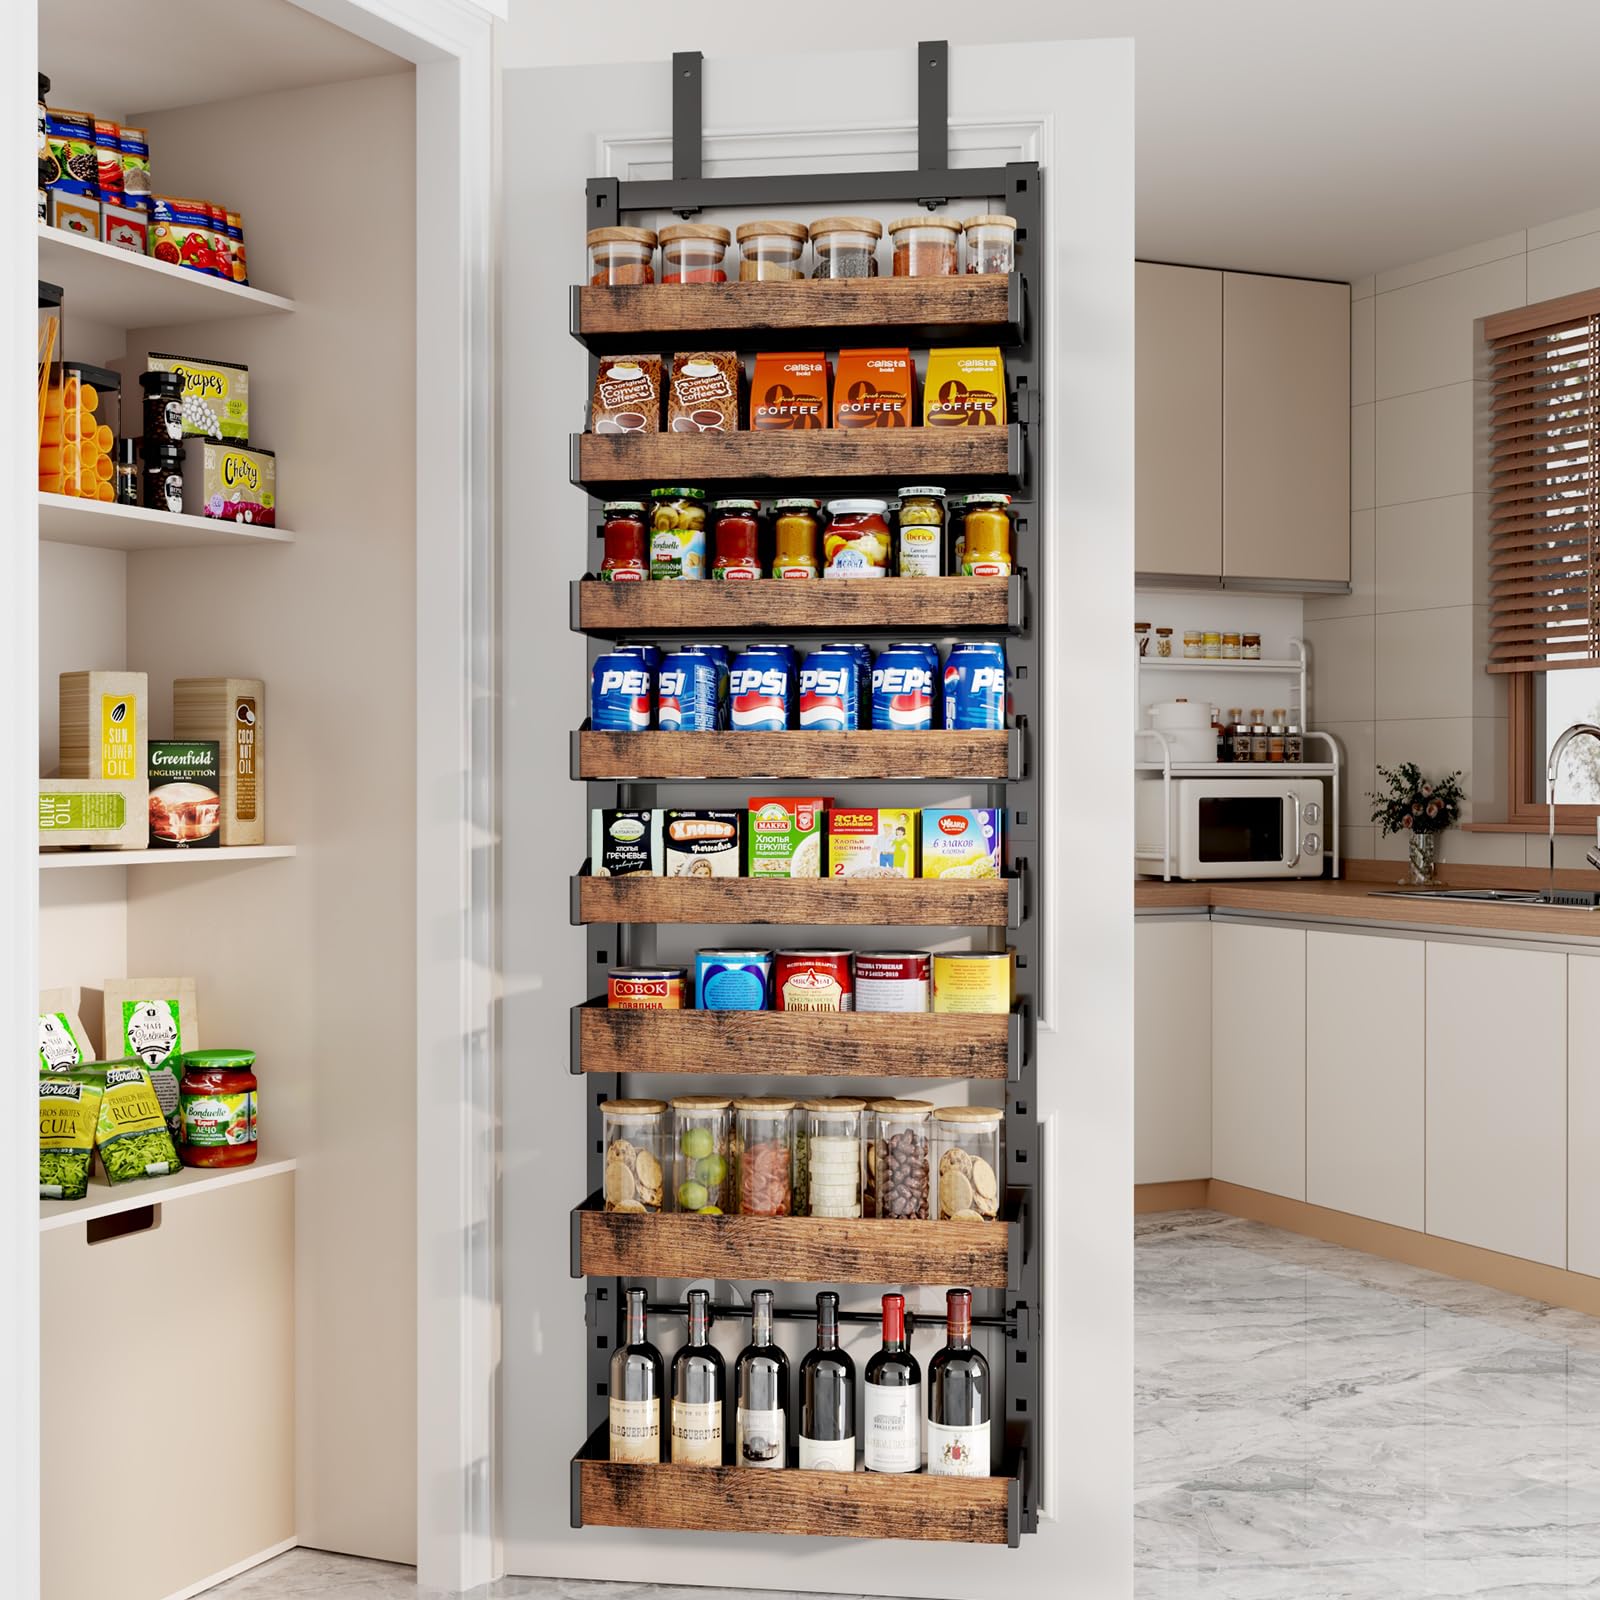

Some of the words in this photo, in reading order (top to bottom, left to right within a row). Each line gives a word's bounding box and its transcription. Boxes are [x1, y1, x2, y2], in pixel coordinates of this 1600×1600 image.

[617, 377, 647, 389] original
[692, 375, 722, 386] original
[604, 384, 649, 398] Conven
[680, 381, 725, 395] Conven
[606, 393, 636, 404] coffee
[682, 390, 714, 401] coffee
[757, 405, 819, 416] COFFEE
[840, 402, 902, 412] COFFEE
[931, 401, 993, 412] COFFEE
[225, 457, 257, 489] Cherry
[906, 533, 932, 541] Iberica
[109, 727, 128, 743] SUN
[238, 729, 254, 744] COCO
[104, 743, 133, 759] FLOWER
[239, 744, 252, 758] NUT
[152, 750, 212, 766] Greenfield
[107, 760, 130, 776] OIL
[239, 759, 254, 774] OIL
[149, 769, 182, 777] ENGLISH
[183, 769, 217, 777] EDITION
[40, 797, 55, 827] OLIVE
[55, 799, 71, 825] OIL
[756, 834, 790, 843] Хлопья
[933, 838, 940, 848] 6
[942, 839, 974, 848] злаков
[756, 843, 793, 851] ГЕРКУЛЕС
[606, 852, 648, 860] ГРЕЧНЕВЫЕ
[834, 863, 845, 875] 2
[616, 983, 666, 994] СОВОК
[188, 1106, 227, 1118] Bonduelle
[40, 1119, 76, 1134] CULA
